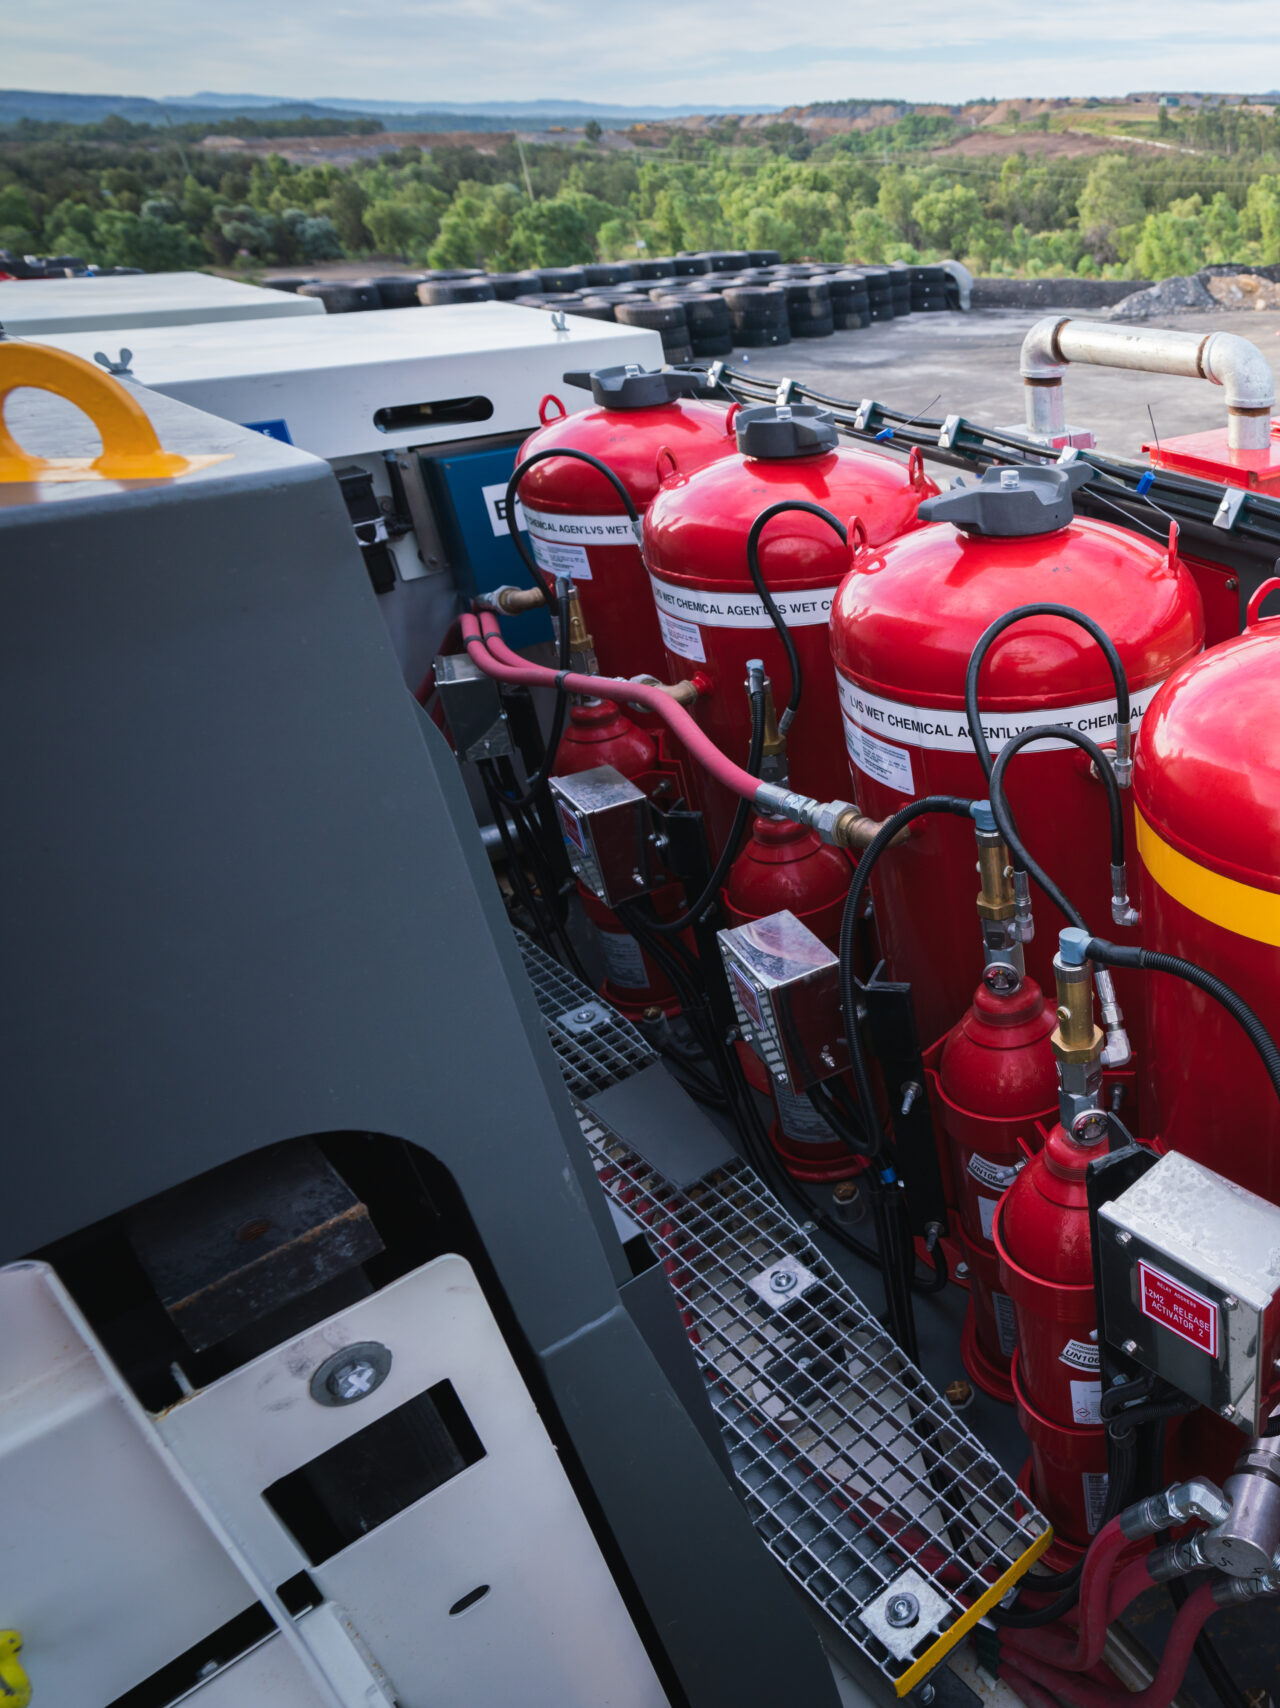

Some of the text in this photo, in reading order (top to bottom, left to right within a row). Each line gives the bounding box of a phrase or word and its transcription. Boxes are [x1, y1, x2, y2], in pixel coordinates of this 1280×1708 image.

[585, 525, 604, 535] LVS
[606, 525, 629, 535] WET
[663, 593, 676, 606] WET
[676, 597, 725, 615] CHEMICAL
[763, 603, 787, 616] LS
[789, 601, 818, 613] WET
[850, 695, 865, 714] LVS
[865, 704, 886, 723] WET
[887, 714, 954, 738] CHEMICAL
[1077, 705, 1145, 732] CHEMAL
[1151, 1300, 1204, 1338] ACTIVATOR 2
[1173, 1304, 1210, 1332] RELEASE
